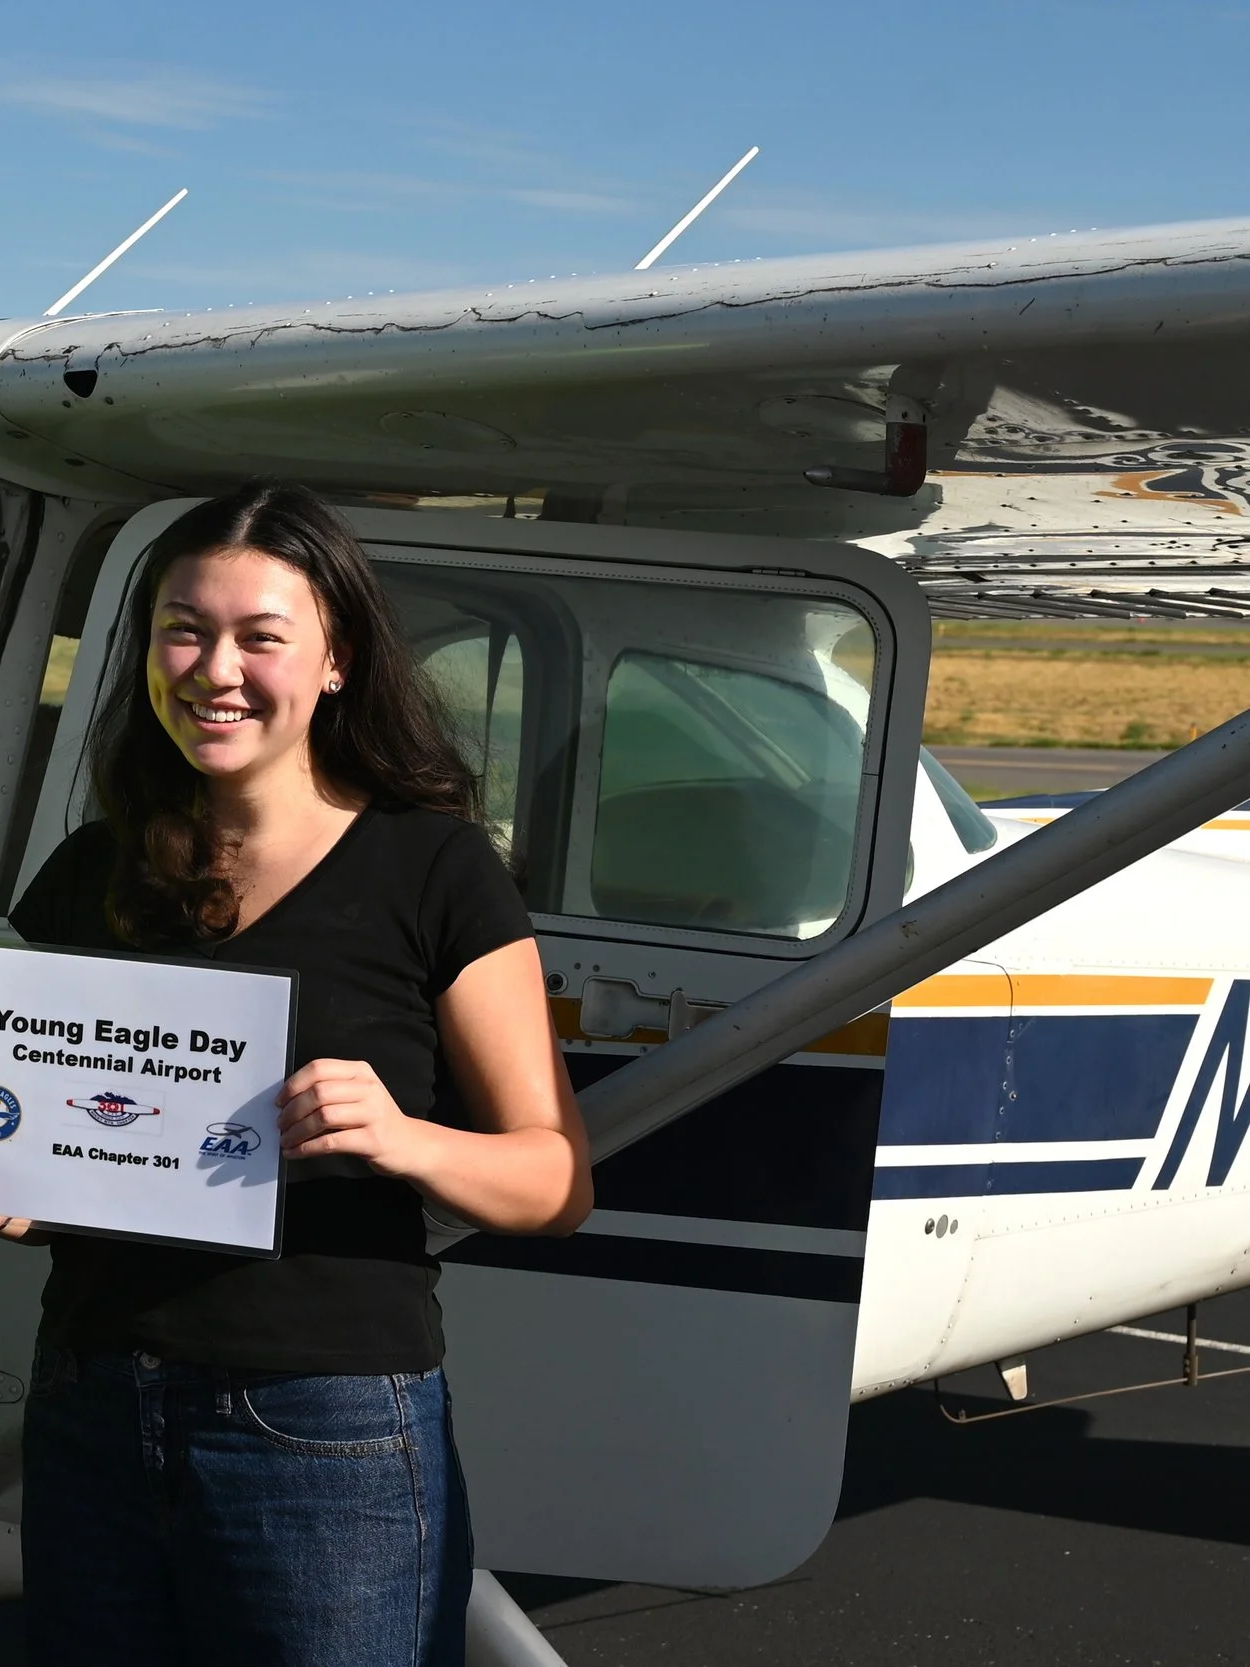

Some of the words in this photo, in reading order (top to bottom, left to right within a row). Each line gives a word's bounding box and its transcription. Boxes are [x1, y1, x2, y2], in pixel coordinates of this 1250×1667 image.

[94, 1019, 179, 1053] Eagle
[189, 1029, 247, 1063] Day
[12, 1043, 134, 1073] Centennial
[140, 1058, 222, 1083] Airport
[52, 1143, 84, 1158] EAA
[88, 1147, 149, 1165] Chapter
[152, 1155, 180, 1170] 301
[200, 1136, 249, 1155] EAA
